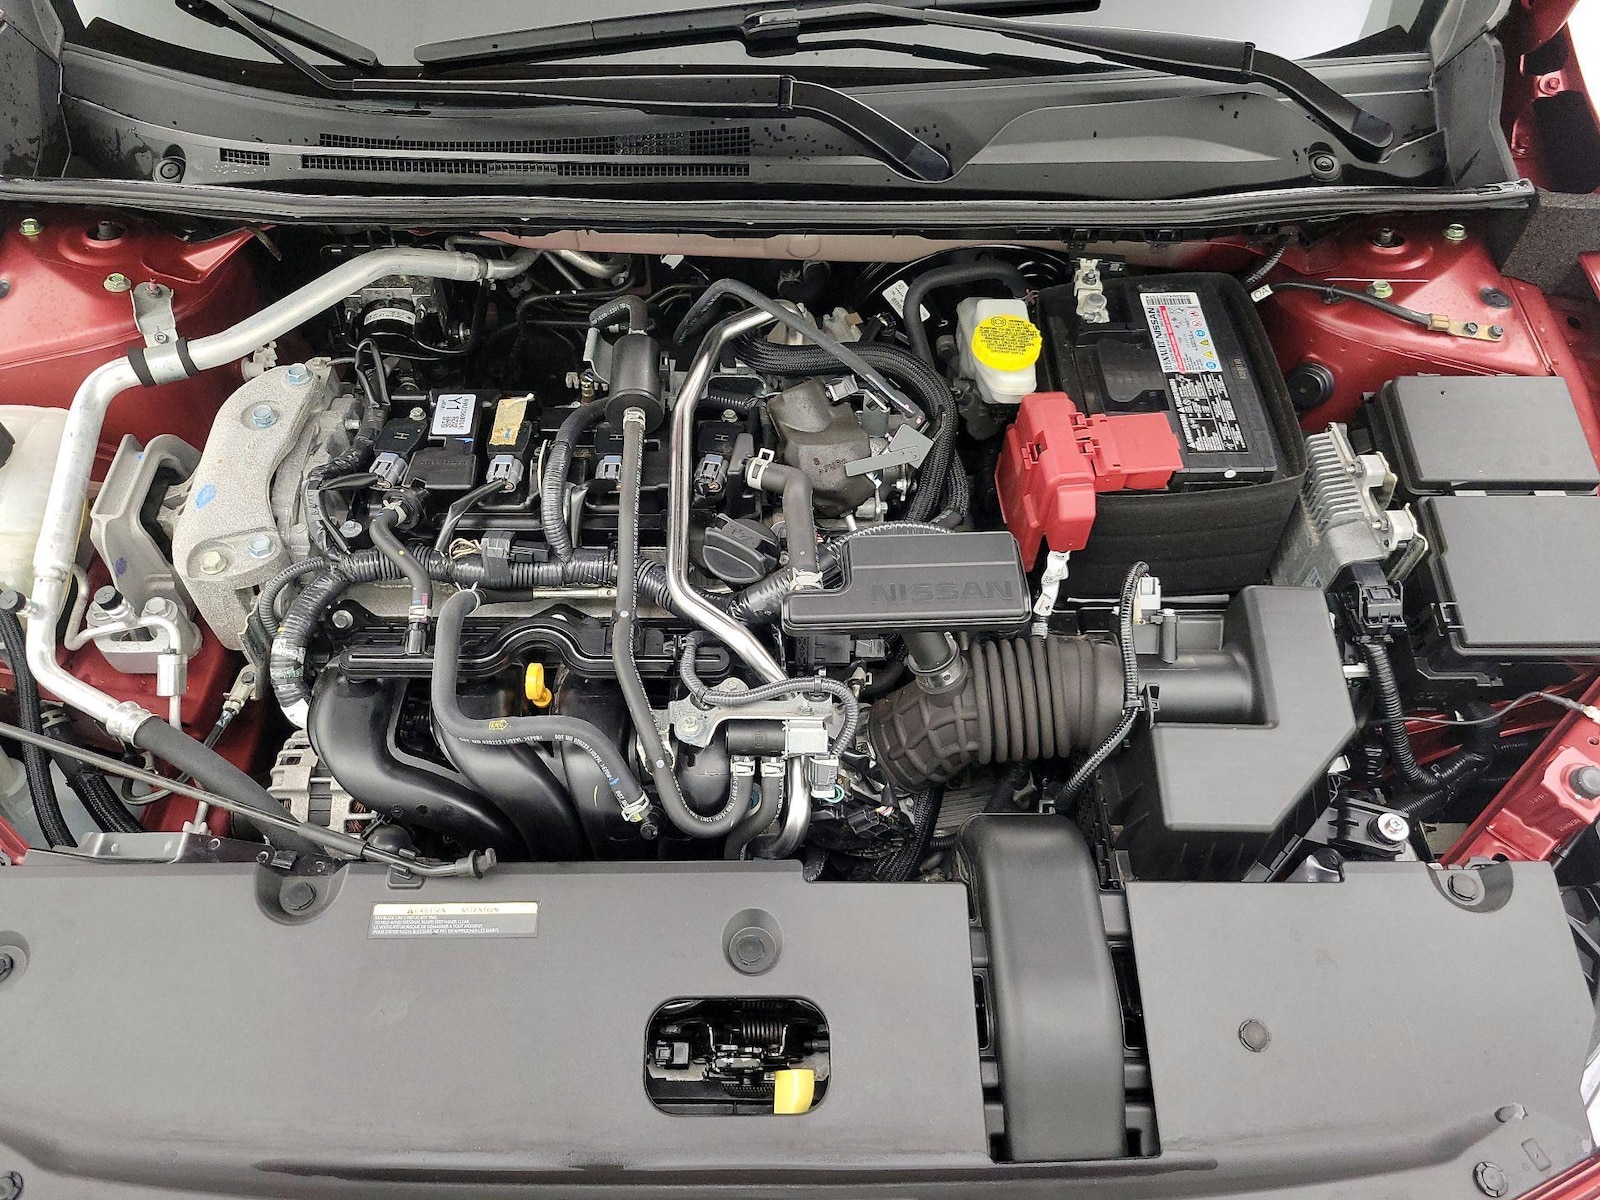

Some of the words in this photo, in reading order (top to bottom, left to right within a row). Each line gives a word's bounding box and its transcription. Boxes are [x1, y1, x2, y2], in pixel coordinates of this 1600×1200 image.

[1148, 307, 1163, 339] NISSAN
[446, 396, 463, 410] Y1
[871, 580, 1014, 604] NISSAN
